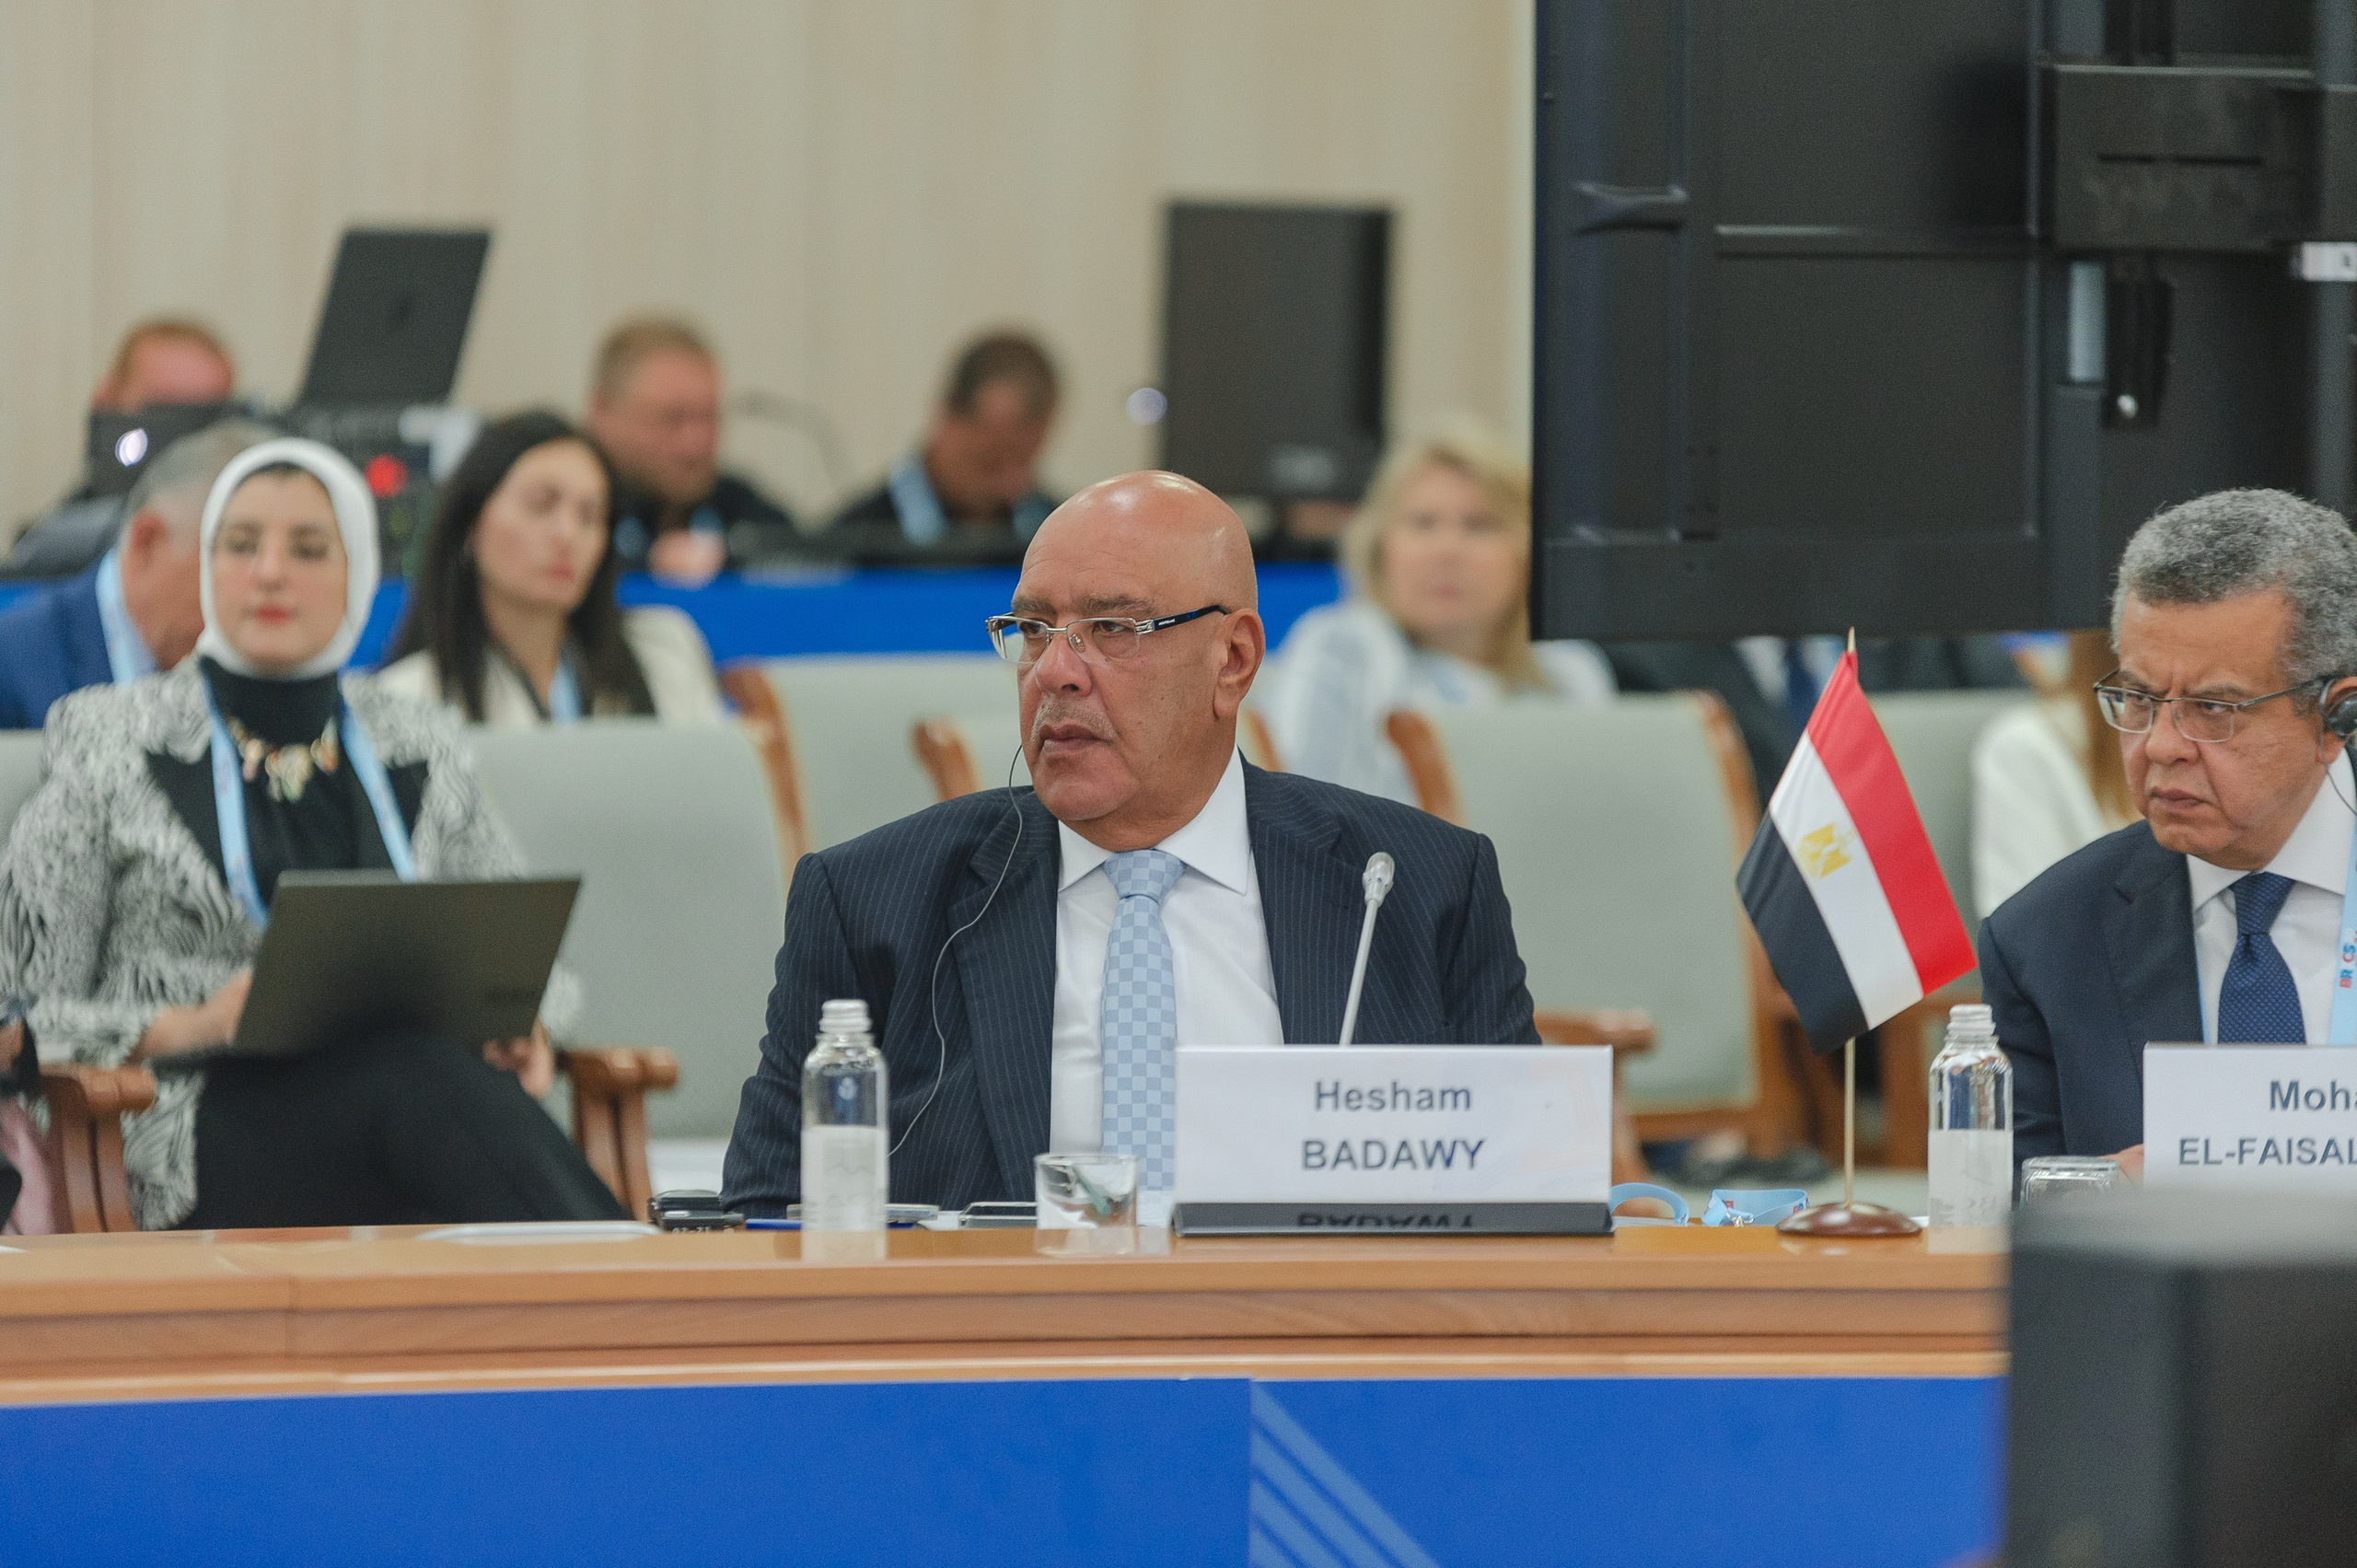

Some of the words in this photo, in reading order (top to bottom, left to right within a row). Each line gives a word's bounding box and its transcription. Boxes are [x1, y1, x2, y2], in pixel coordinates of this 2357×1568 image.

[1316, 1080, 1471, 1111] Hesham
[2270, 1080, 2357, 1111] Moh
[1302, 1139, 1485, 1170] BADAWY
[2179, 1137, 2357, 1165] EL-FAISAL
